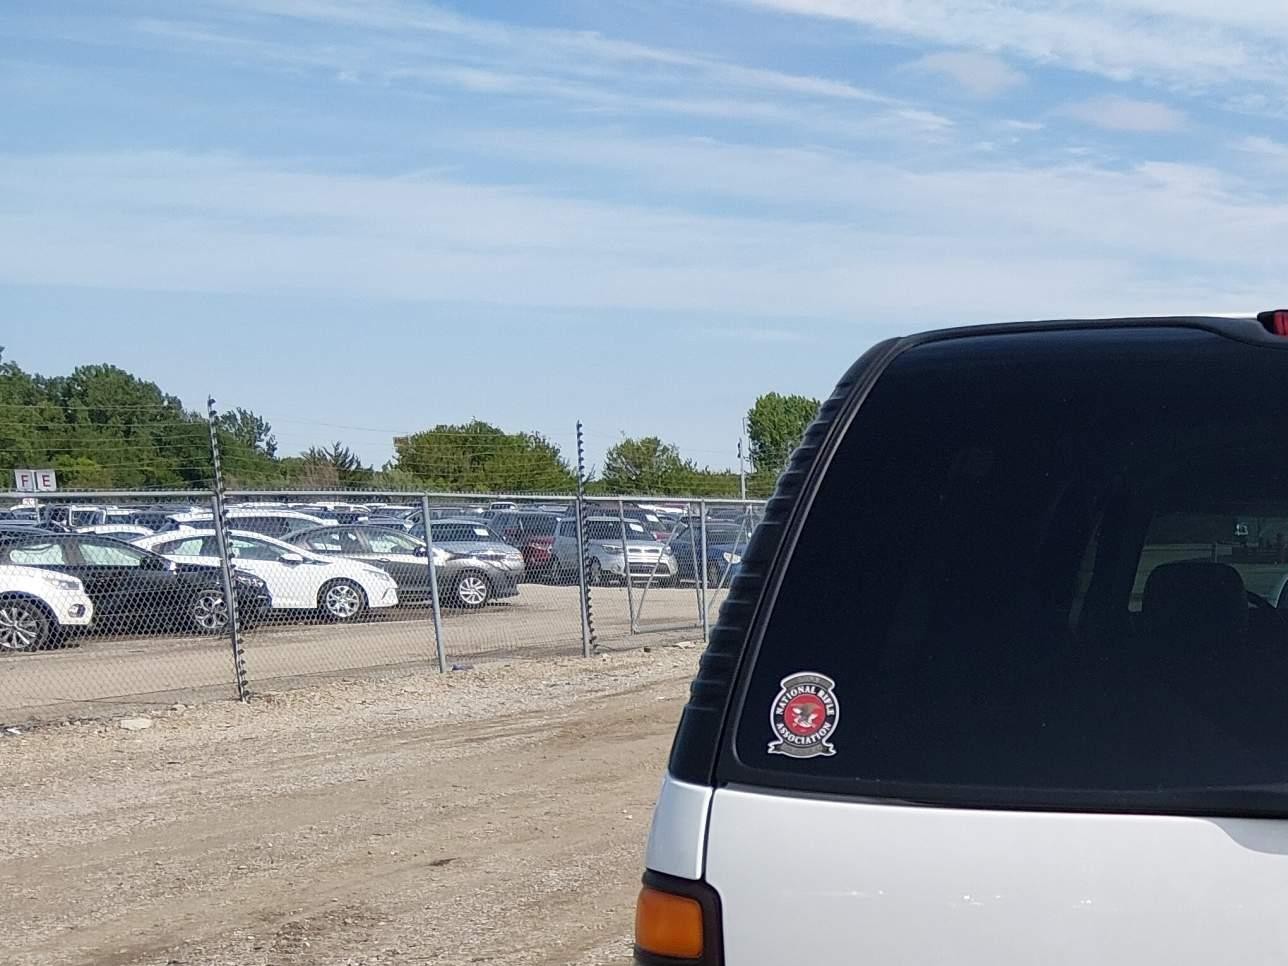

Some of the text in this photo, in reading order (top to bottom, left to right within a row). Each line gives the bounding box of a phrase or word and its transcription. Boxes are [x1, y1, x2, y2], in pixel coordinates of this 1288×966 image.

[20, 474, 52, 488] F E
[775, 685, 836, 716] NATIONAL RIFLE
[775, 721, 832, 745] ASSOCIATION
